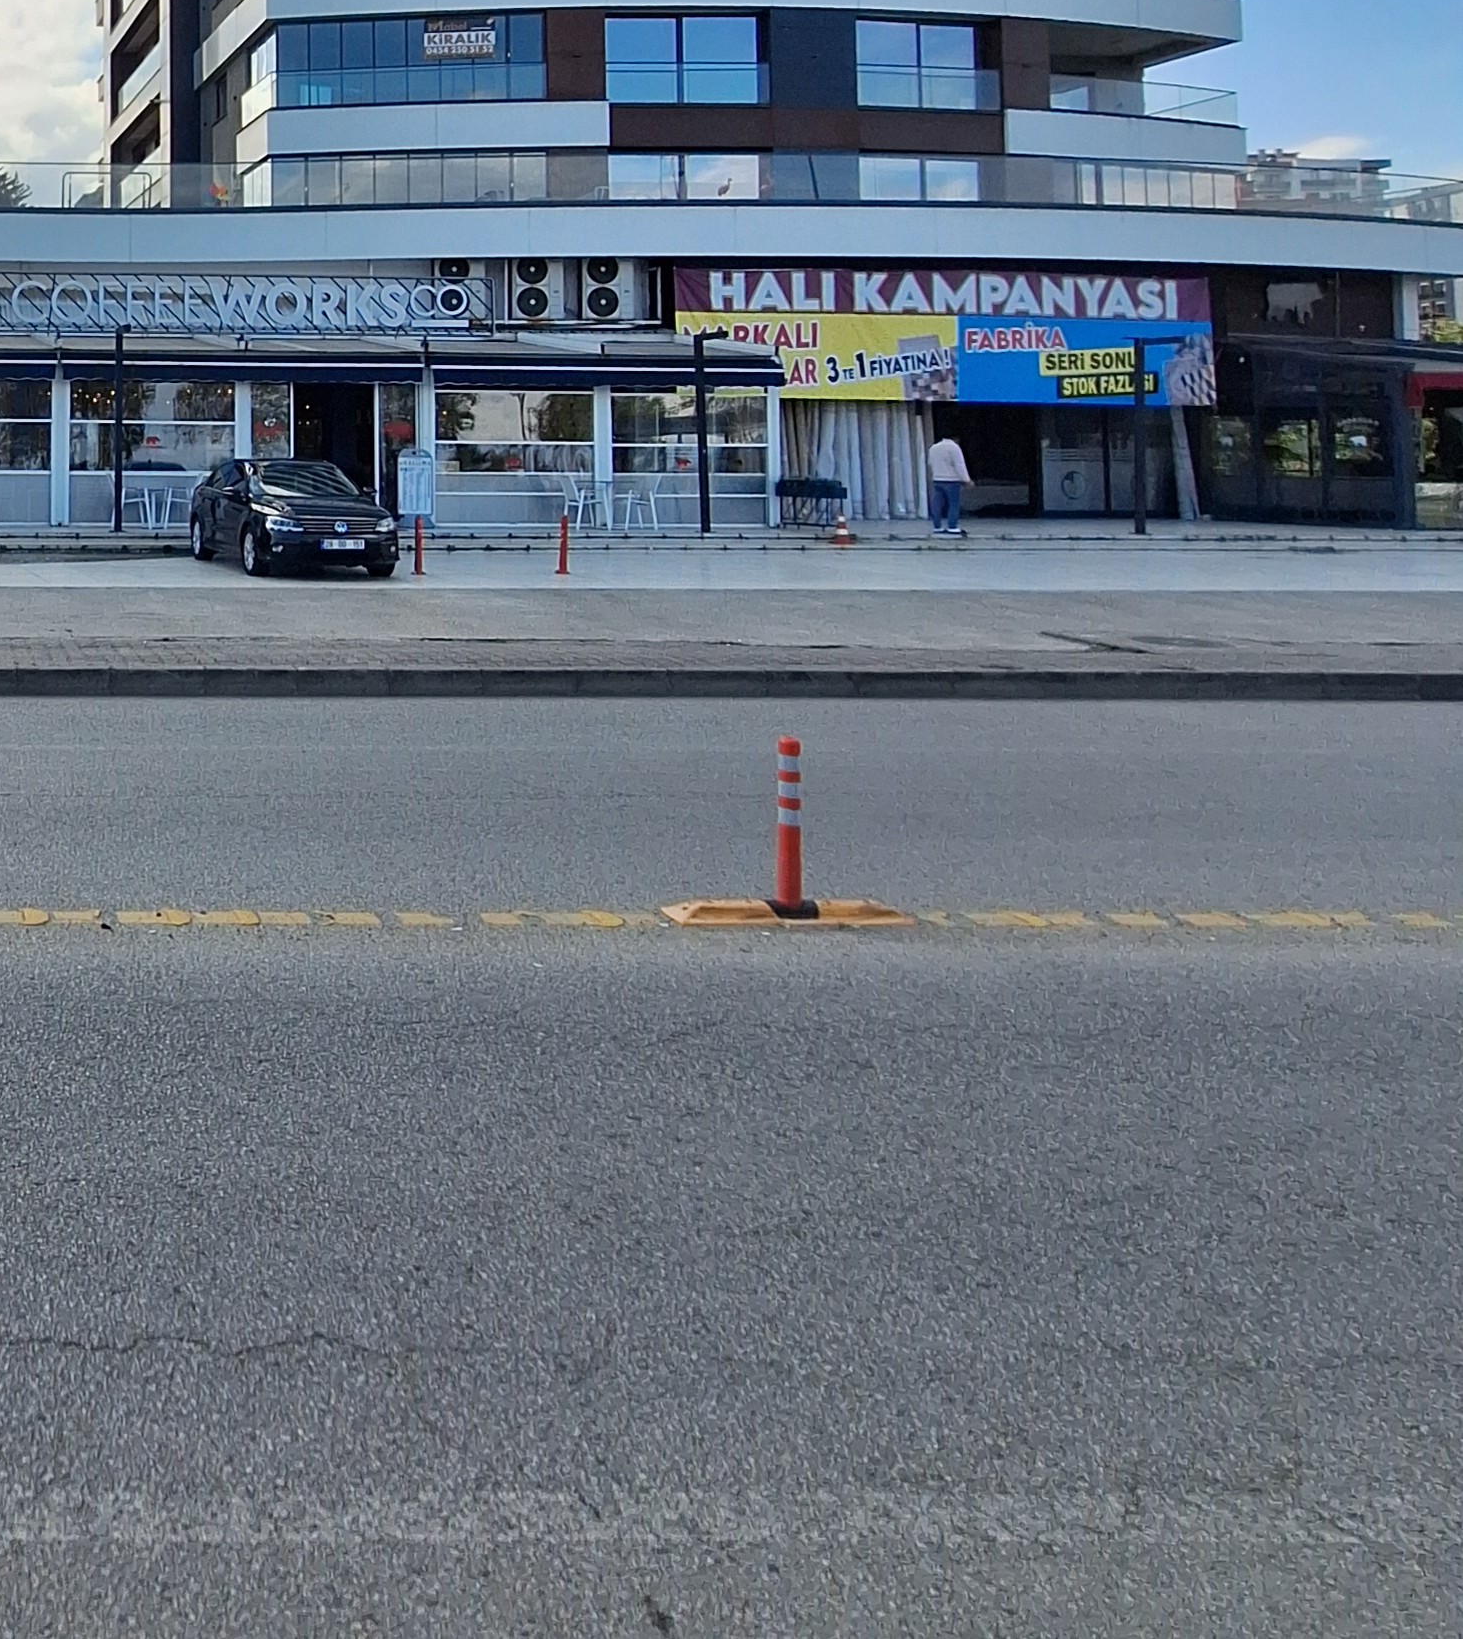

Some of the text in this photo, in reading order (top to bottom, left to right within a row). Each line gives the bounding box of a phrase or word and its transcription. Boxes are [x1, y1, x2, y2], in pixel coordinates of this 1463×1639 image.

[709, 271, 1178, 321] HALI KAMPANYASI
[966, 323, 1066, 350] FABRİKA
[1062, 373, 1154, 396] STOK FAZLSI
